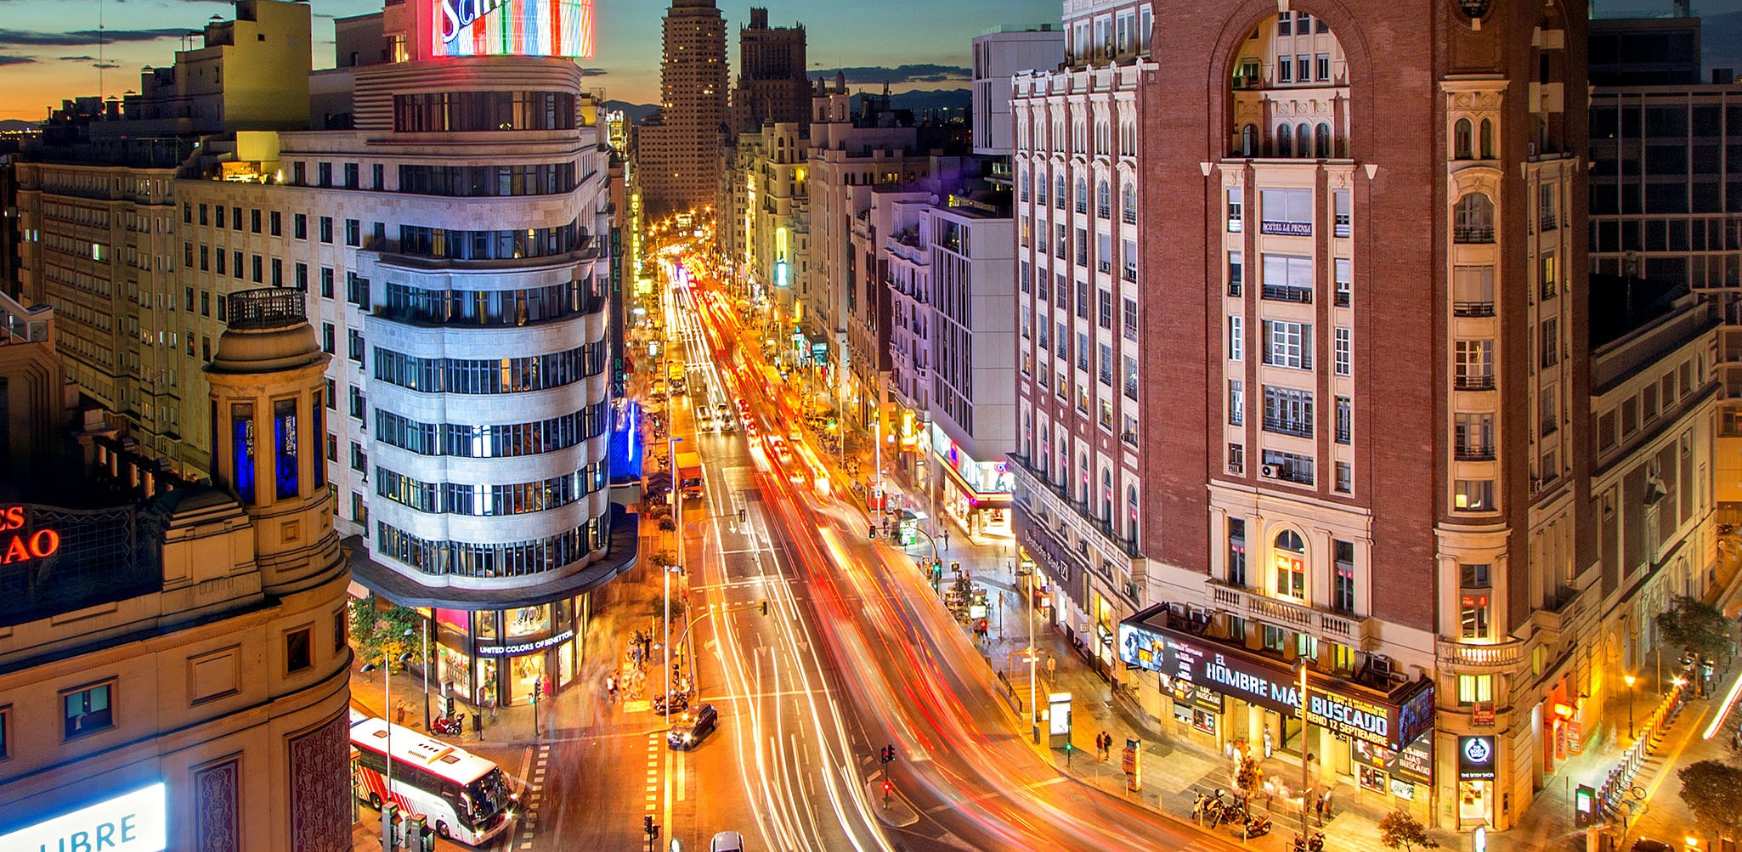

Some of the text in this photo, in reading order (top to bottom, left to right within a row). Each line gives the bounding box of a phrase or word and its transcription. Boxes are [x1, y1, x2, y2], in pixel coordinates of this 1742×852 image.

[1264, 223, 1282, 231] HOSTAL
[1283, 223, 1290, 232] LA
[612, 230, 622, 393] HOTEL REX
[0, 529, 59, 564] AO
[480, 630, 573, 654] UNITED COLORS OF BENETTON
[1216, 653, 1226, 666] EL
[1206, 662, 1268, 697] HOMBRE
[1311, 696, 1388, 736] BUSCADO
[1294, 708, 1388, 747] ESRENO 12 SEPTIEMBRE
